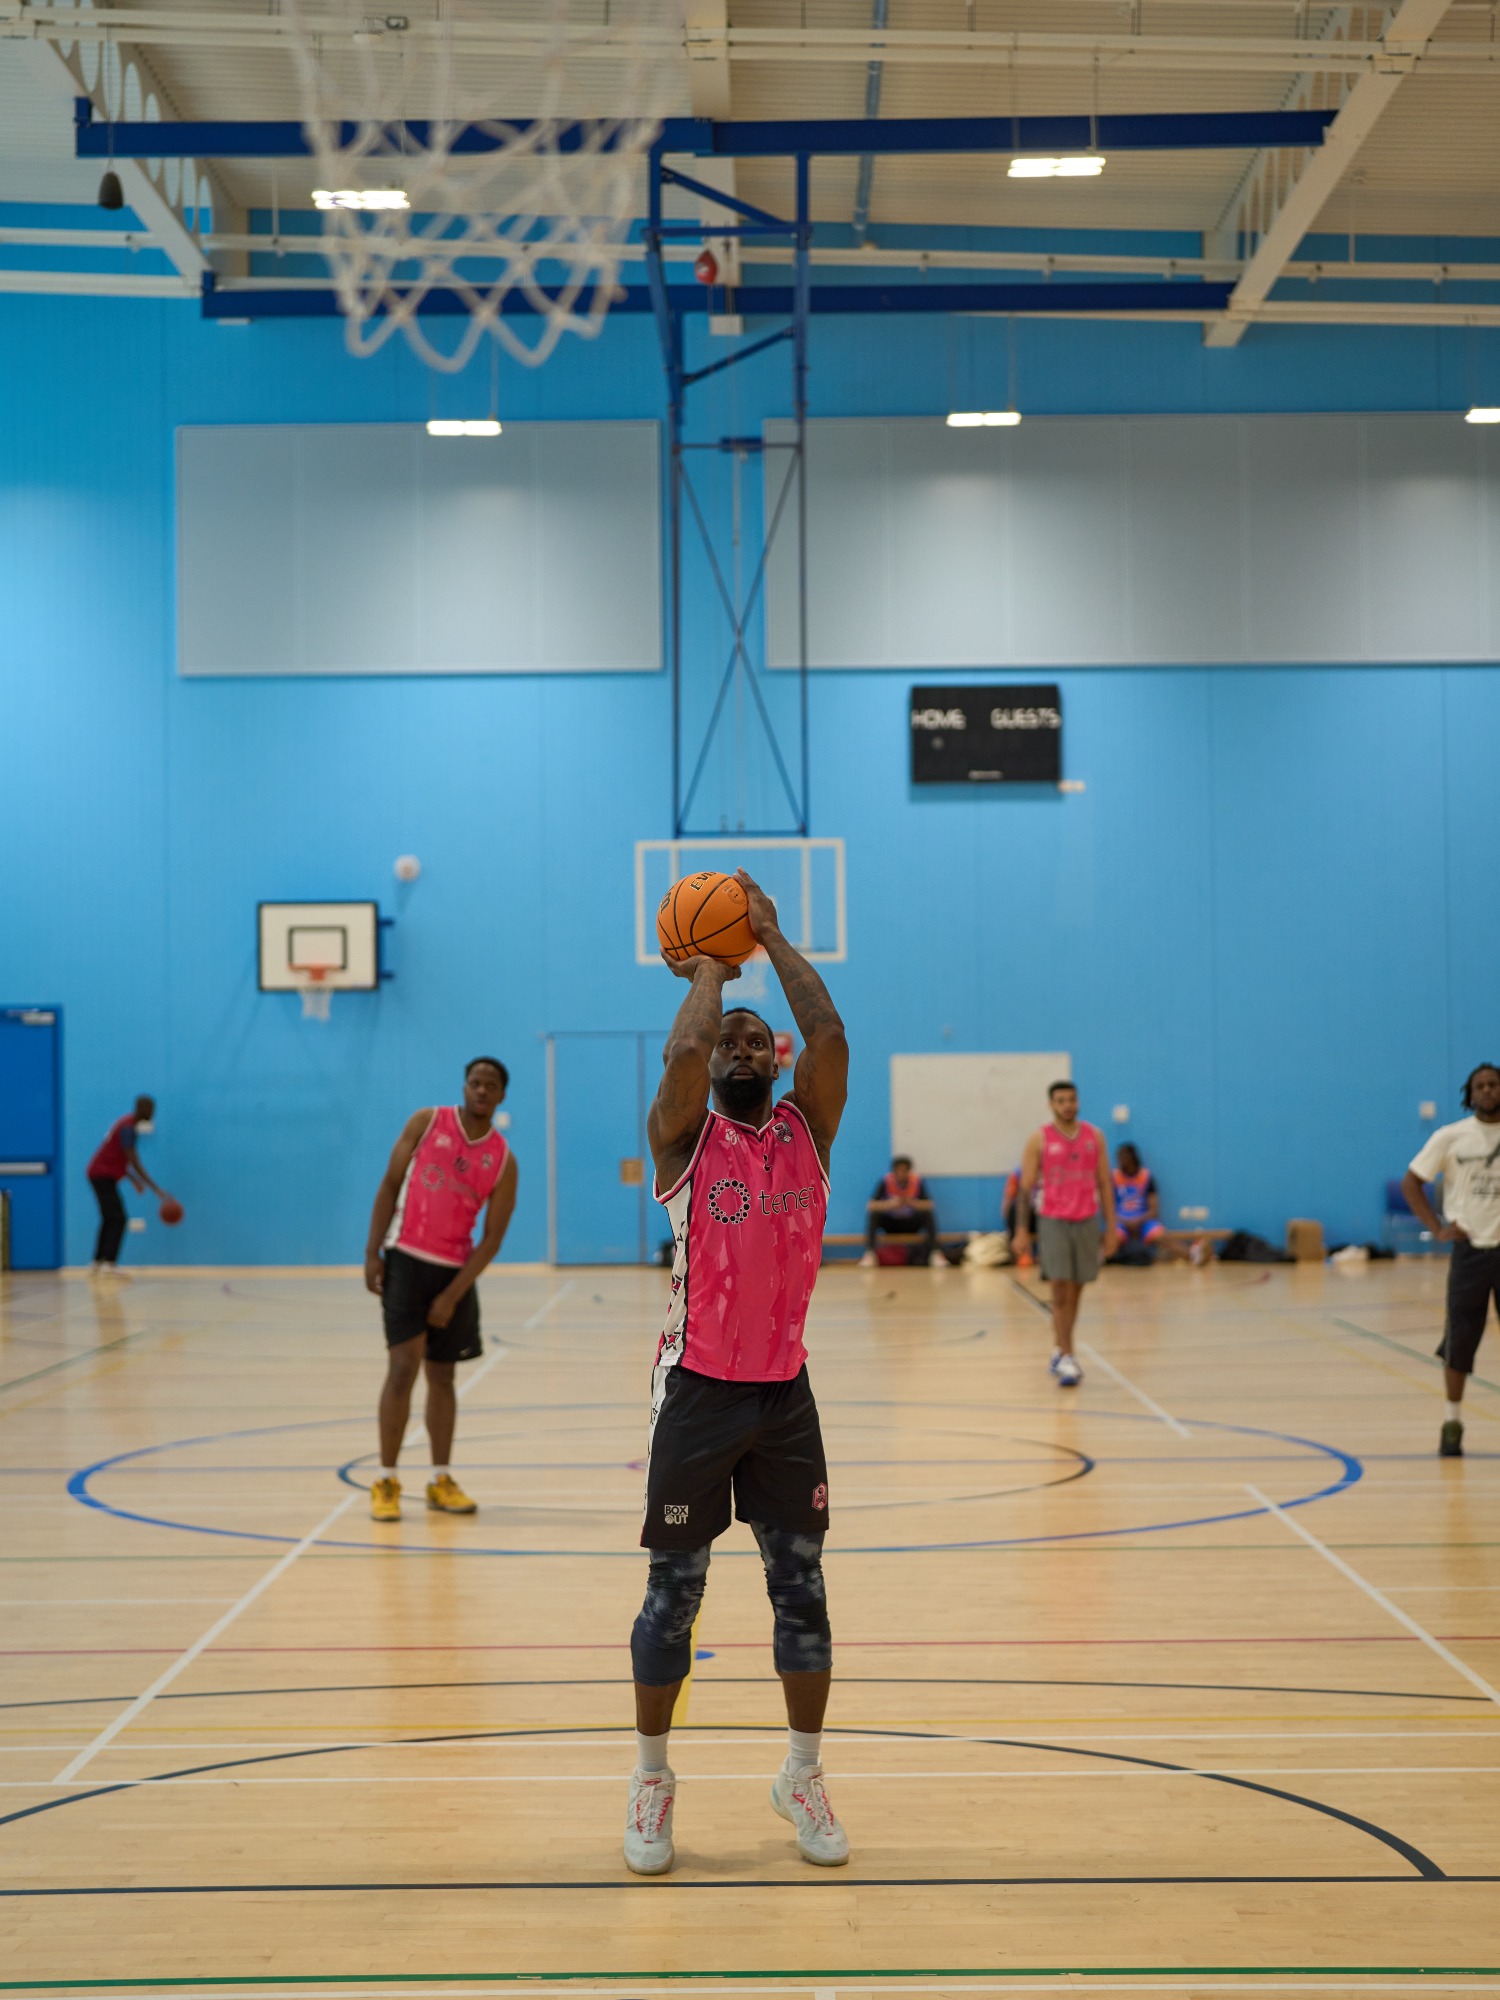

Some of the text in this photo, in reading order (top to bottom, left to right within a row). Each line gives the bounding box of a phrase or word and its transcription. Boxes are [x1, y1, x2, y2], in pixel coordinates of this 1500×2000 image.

[911, 707, 1062, 730] HOME GUESTS
[665, 1505, 688, 1515] BOX
[665, 1515, 688, 1524] OUT
